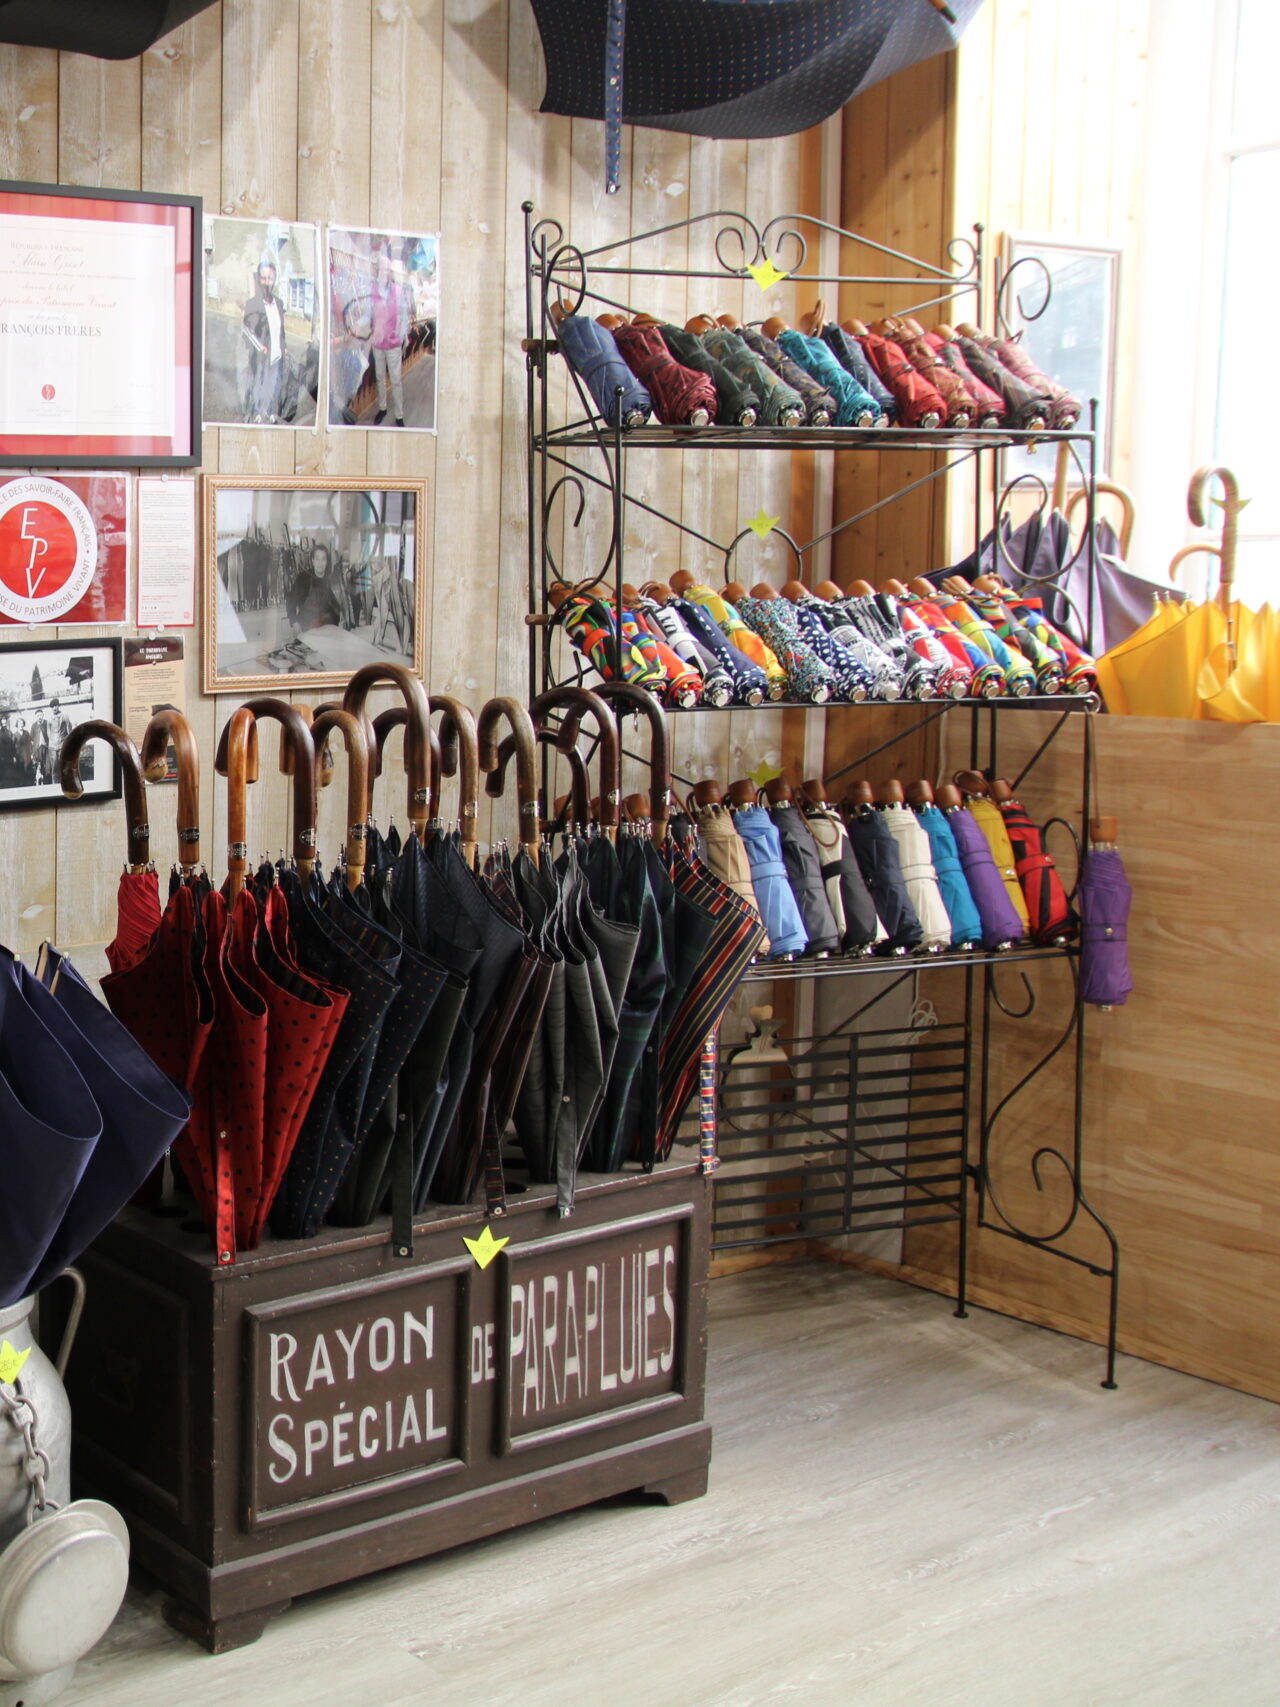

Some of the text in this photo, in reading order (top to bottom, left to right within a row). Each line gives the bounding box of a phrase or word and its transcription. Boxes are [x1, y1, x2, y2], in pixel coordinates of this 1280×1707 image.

[7, 485, 23, 498] DES
[24, 483, 75, 508] SAVOIR-FAIRE
[73, 506, 91, 547] FRANÇAIS
[9, 602, 23, 613] DU
[24, 591, 74, 616] PATRIMOINE
[72, 559, 90, 592] VIVANT
[268, 1305, 435, 1402] RAYON
[470, 1244, 676, 1416] DE PARAPLUIES
[267, 1388, 448, 1484] SPÉCIAL
